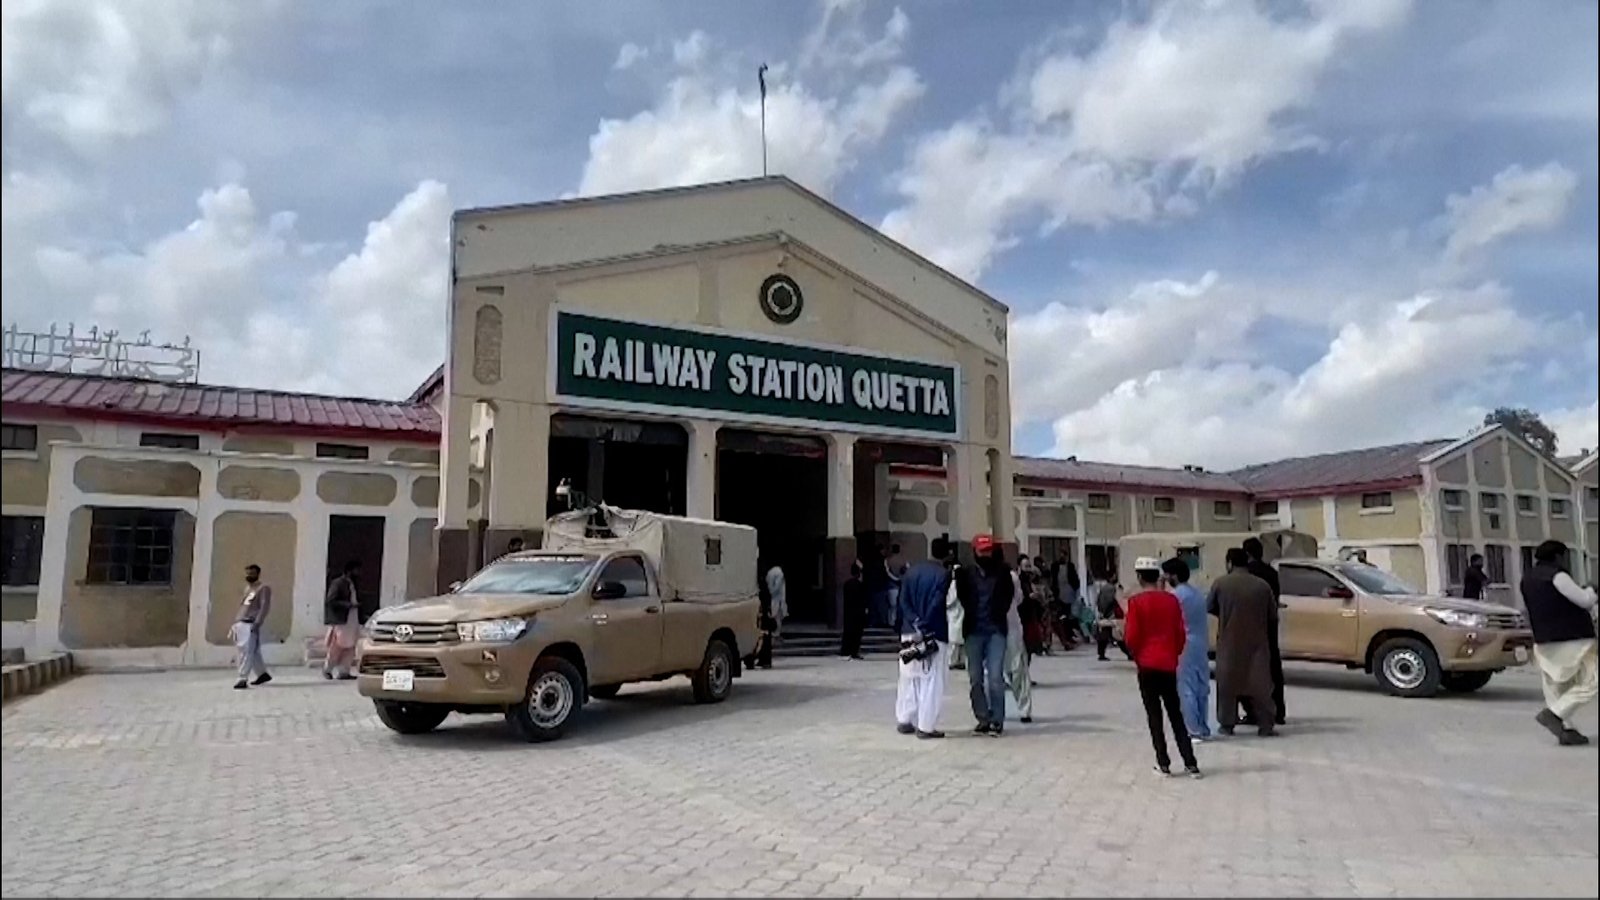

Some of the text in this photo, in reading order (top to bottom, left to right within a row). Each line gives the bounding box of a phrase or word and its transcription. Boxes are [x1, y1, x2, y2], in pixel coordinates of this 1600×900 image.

[573, 333, 950, 416] RAILWAY STATION QUETTA
